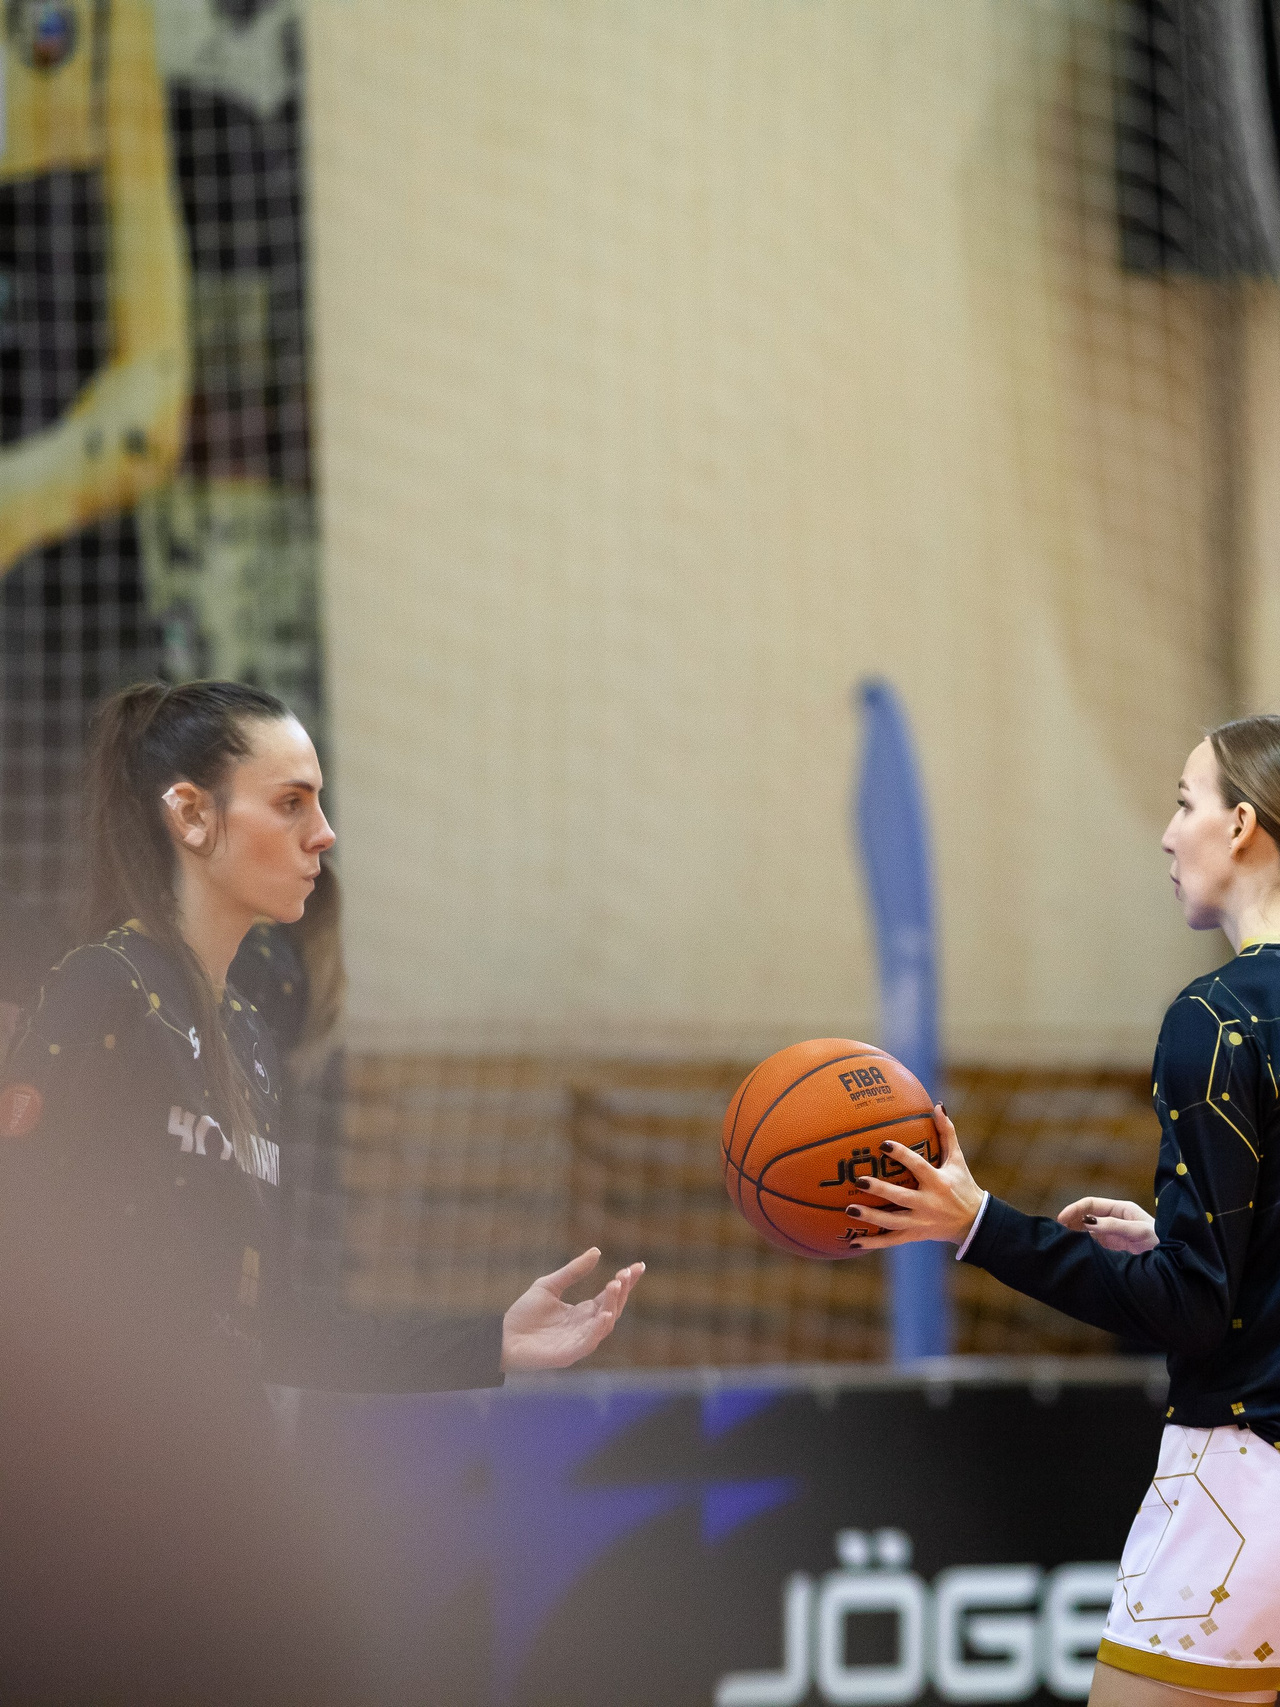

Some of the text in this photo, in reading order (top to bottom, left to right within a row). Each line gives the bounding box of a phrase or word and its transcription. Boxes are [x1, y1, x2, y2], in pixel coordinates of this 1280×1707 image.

[838, 1066, 887, 1092] FIBA
[850, 1085, 892, 1102] APPROVED
[714, 1526, 1120, 1707] JÖGE
